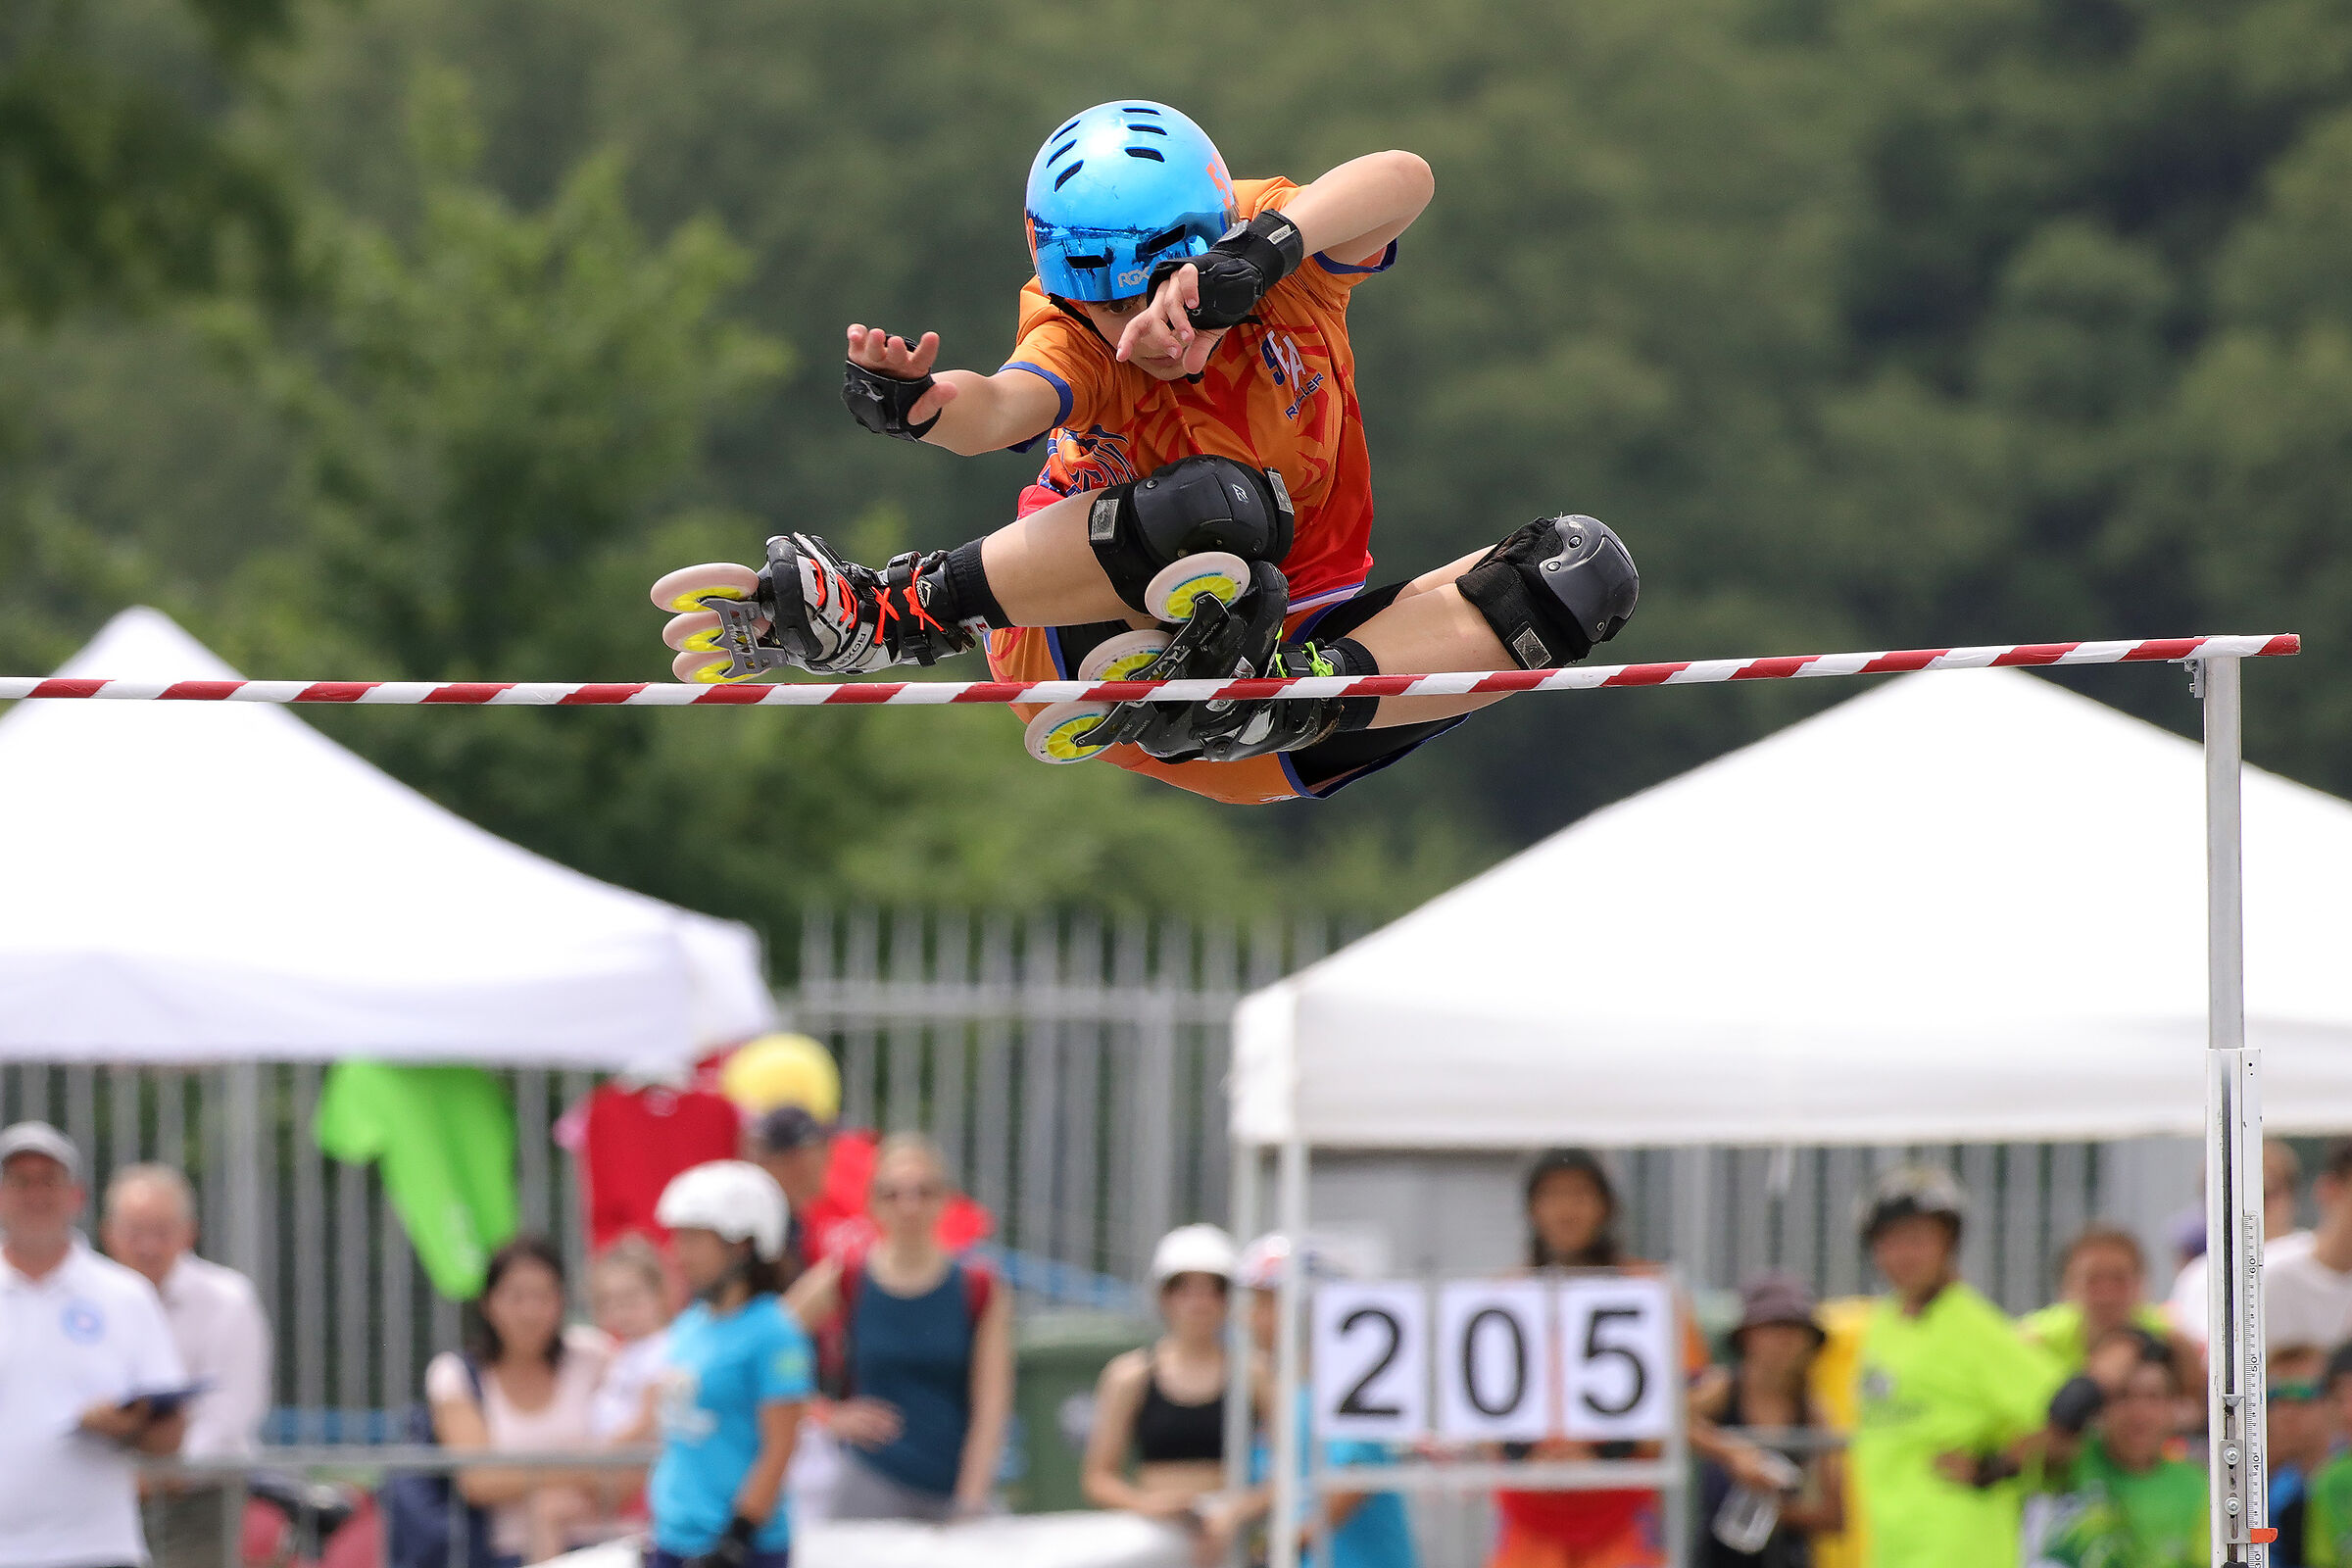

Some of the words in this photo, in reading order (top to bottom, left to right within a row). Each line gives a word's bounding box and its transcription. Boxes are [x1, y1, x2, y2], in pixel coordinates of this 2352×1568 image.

[2249, 1257, 2256, 1274] 60
[1336, 1308, 1646, 1417] 205
[2250, 1356, 2258, 1372] 50
